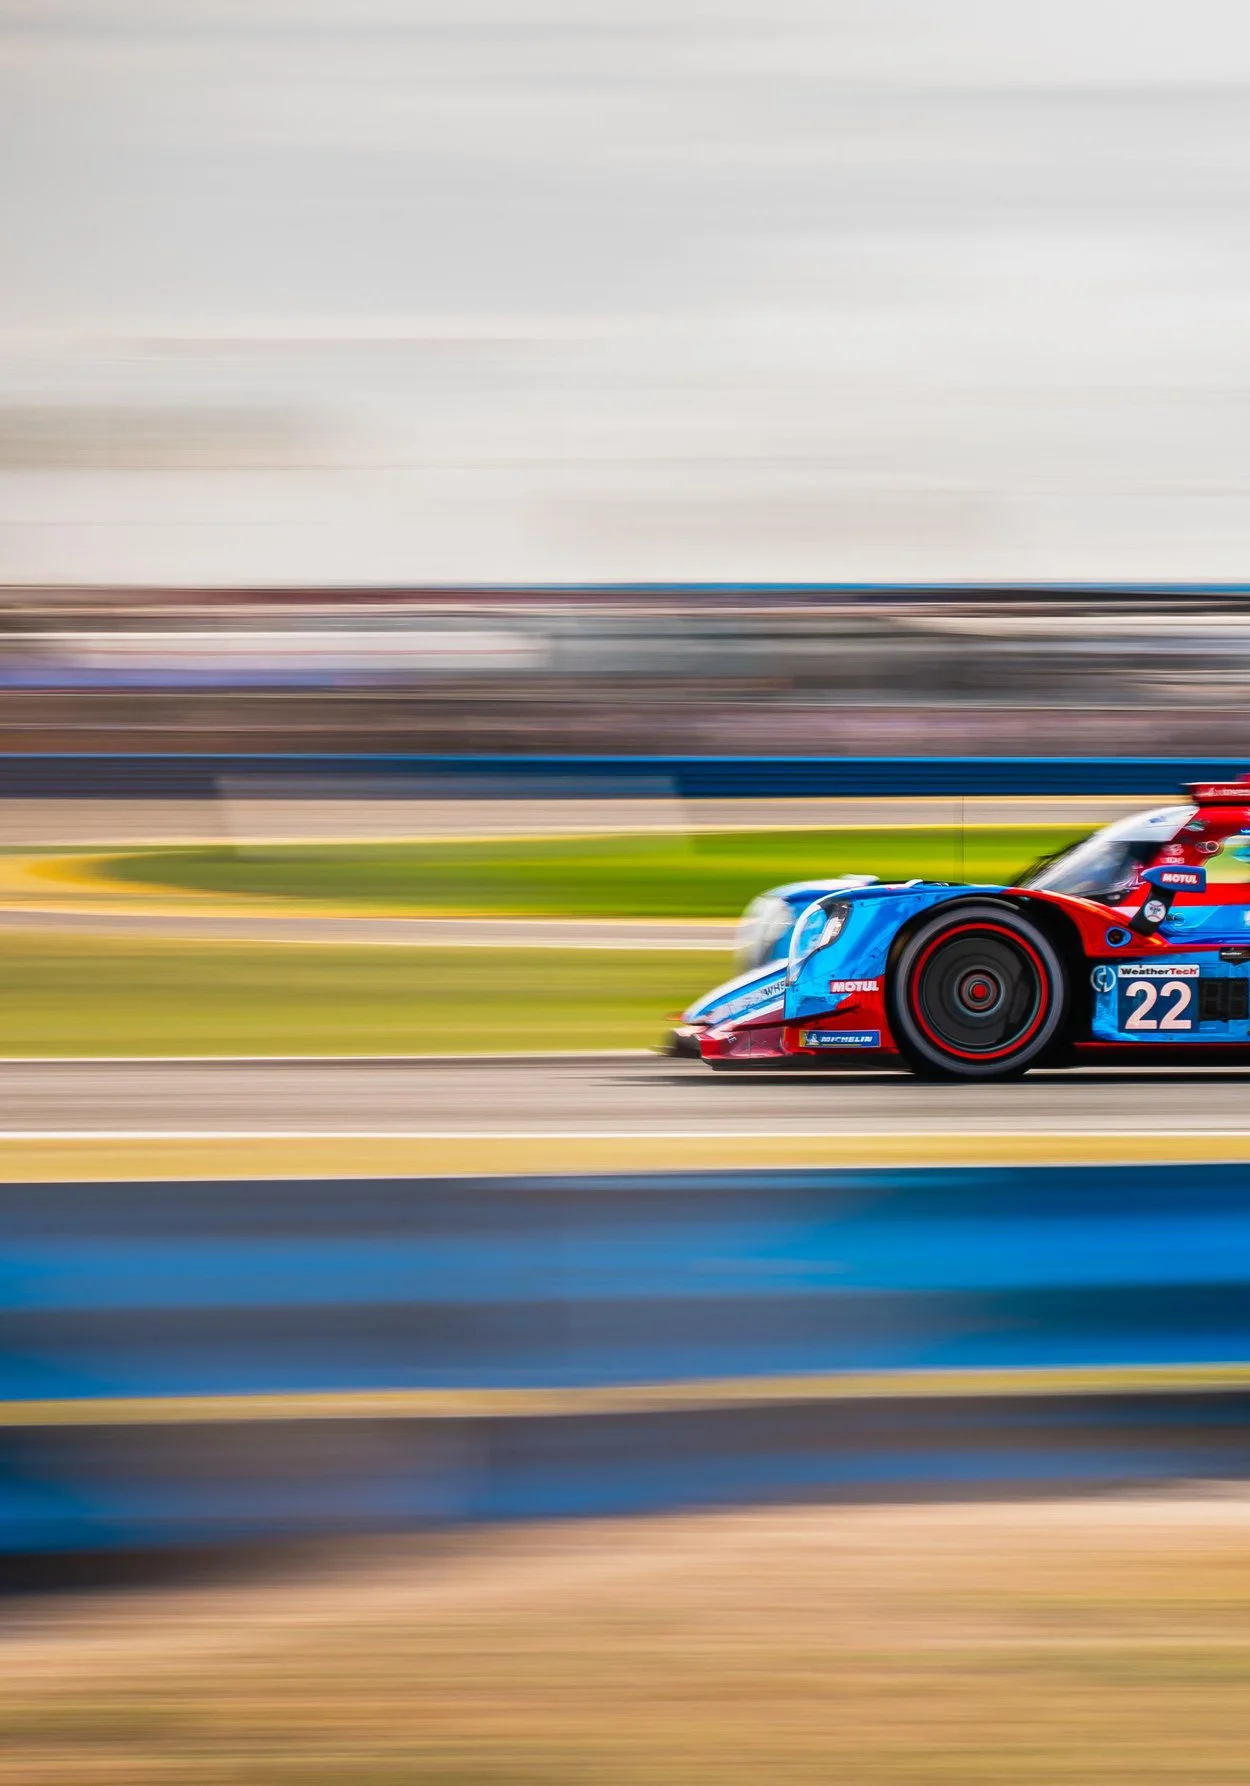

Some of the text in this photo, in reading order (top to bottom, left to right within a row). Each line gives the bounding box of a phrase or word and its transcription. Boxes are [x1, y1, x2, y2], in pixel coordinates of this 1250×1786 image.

[1162, 872, 1198, 884] MOTUL
[1120, 967, 1197, 975] WeatherTech
[832, 980, 880, 993] MOTUL
[1124, 980, 1192, 1030] 22
[820, 1035, 874, 1043] MICHELIN
